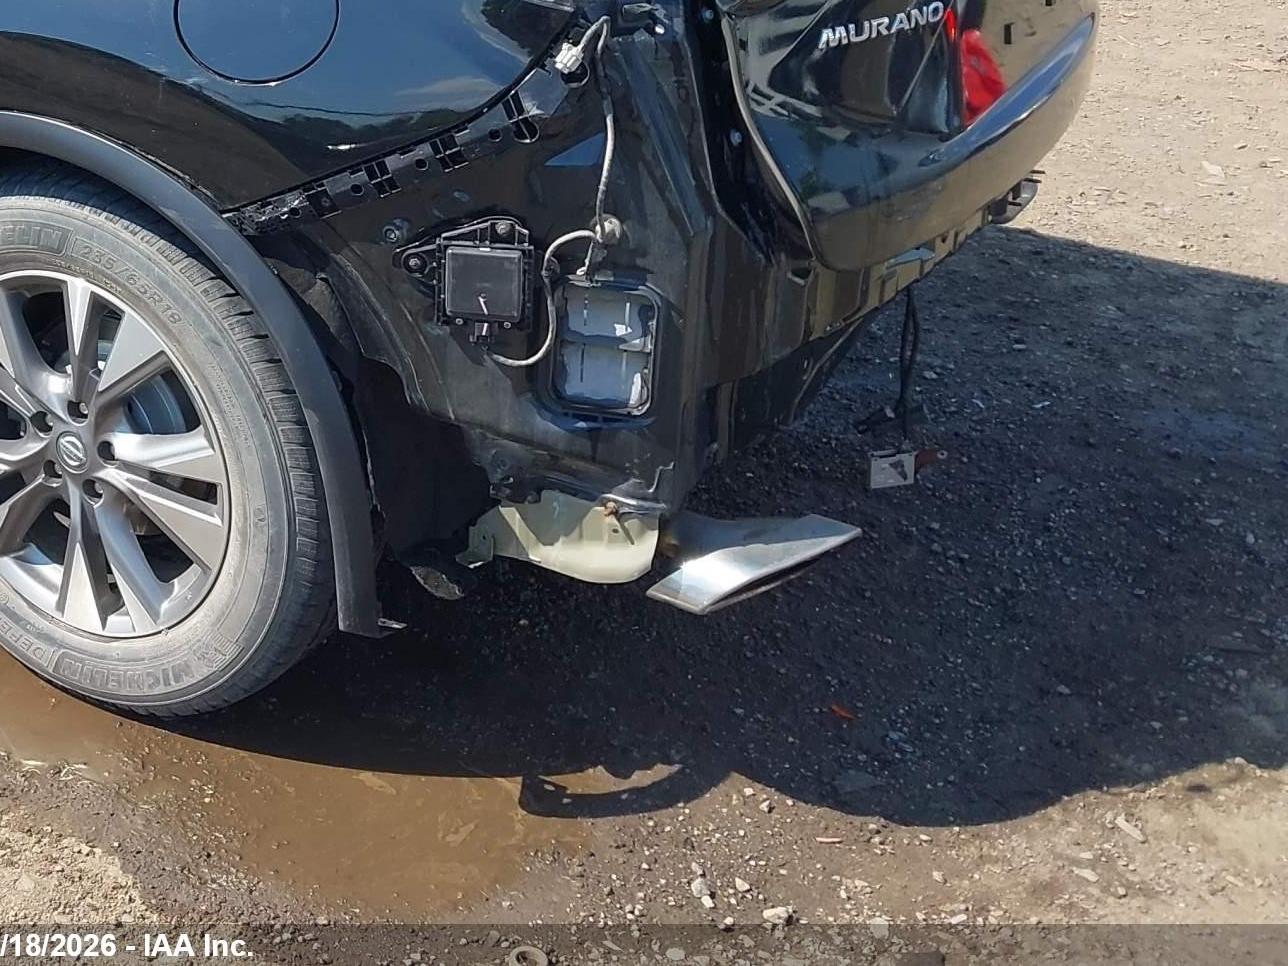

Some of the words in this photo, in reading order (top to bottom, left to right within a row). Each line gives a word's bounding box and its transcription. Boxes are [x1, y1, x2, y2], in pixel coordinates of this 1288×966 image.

[818, 1, 944, 50] MURANO
[80, 243, 183, 325] 235/65R18
[63, 657, 196, 691] MICHELIN
